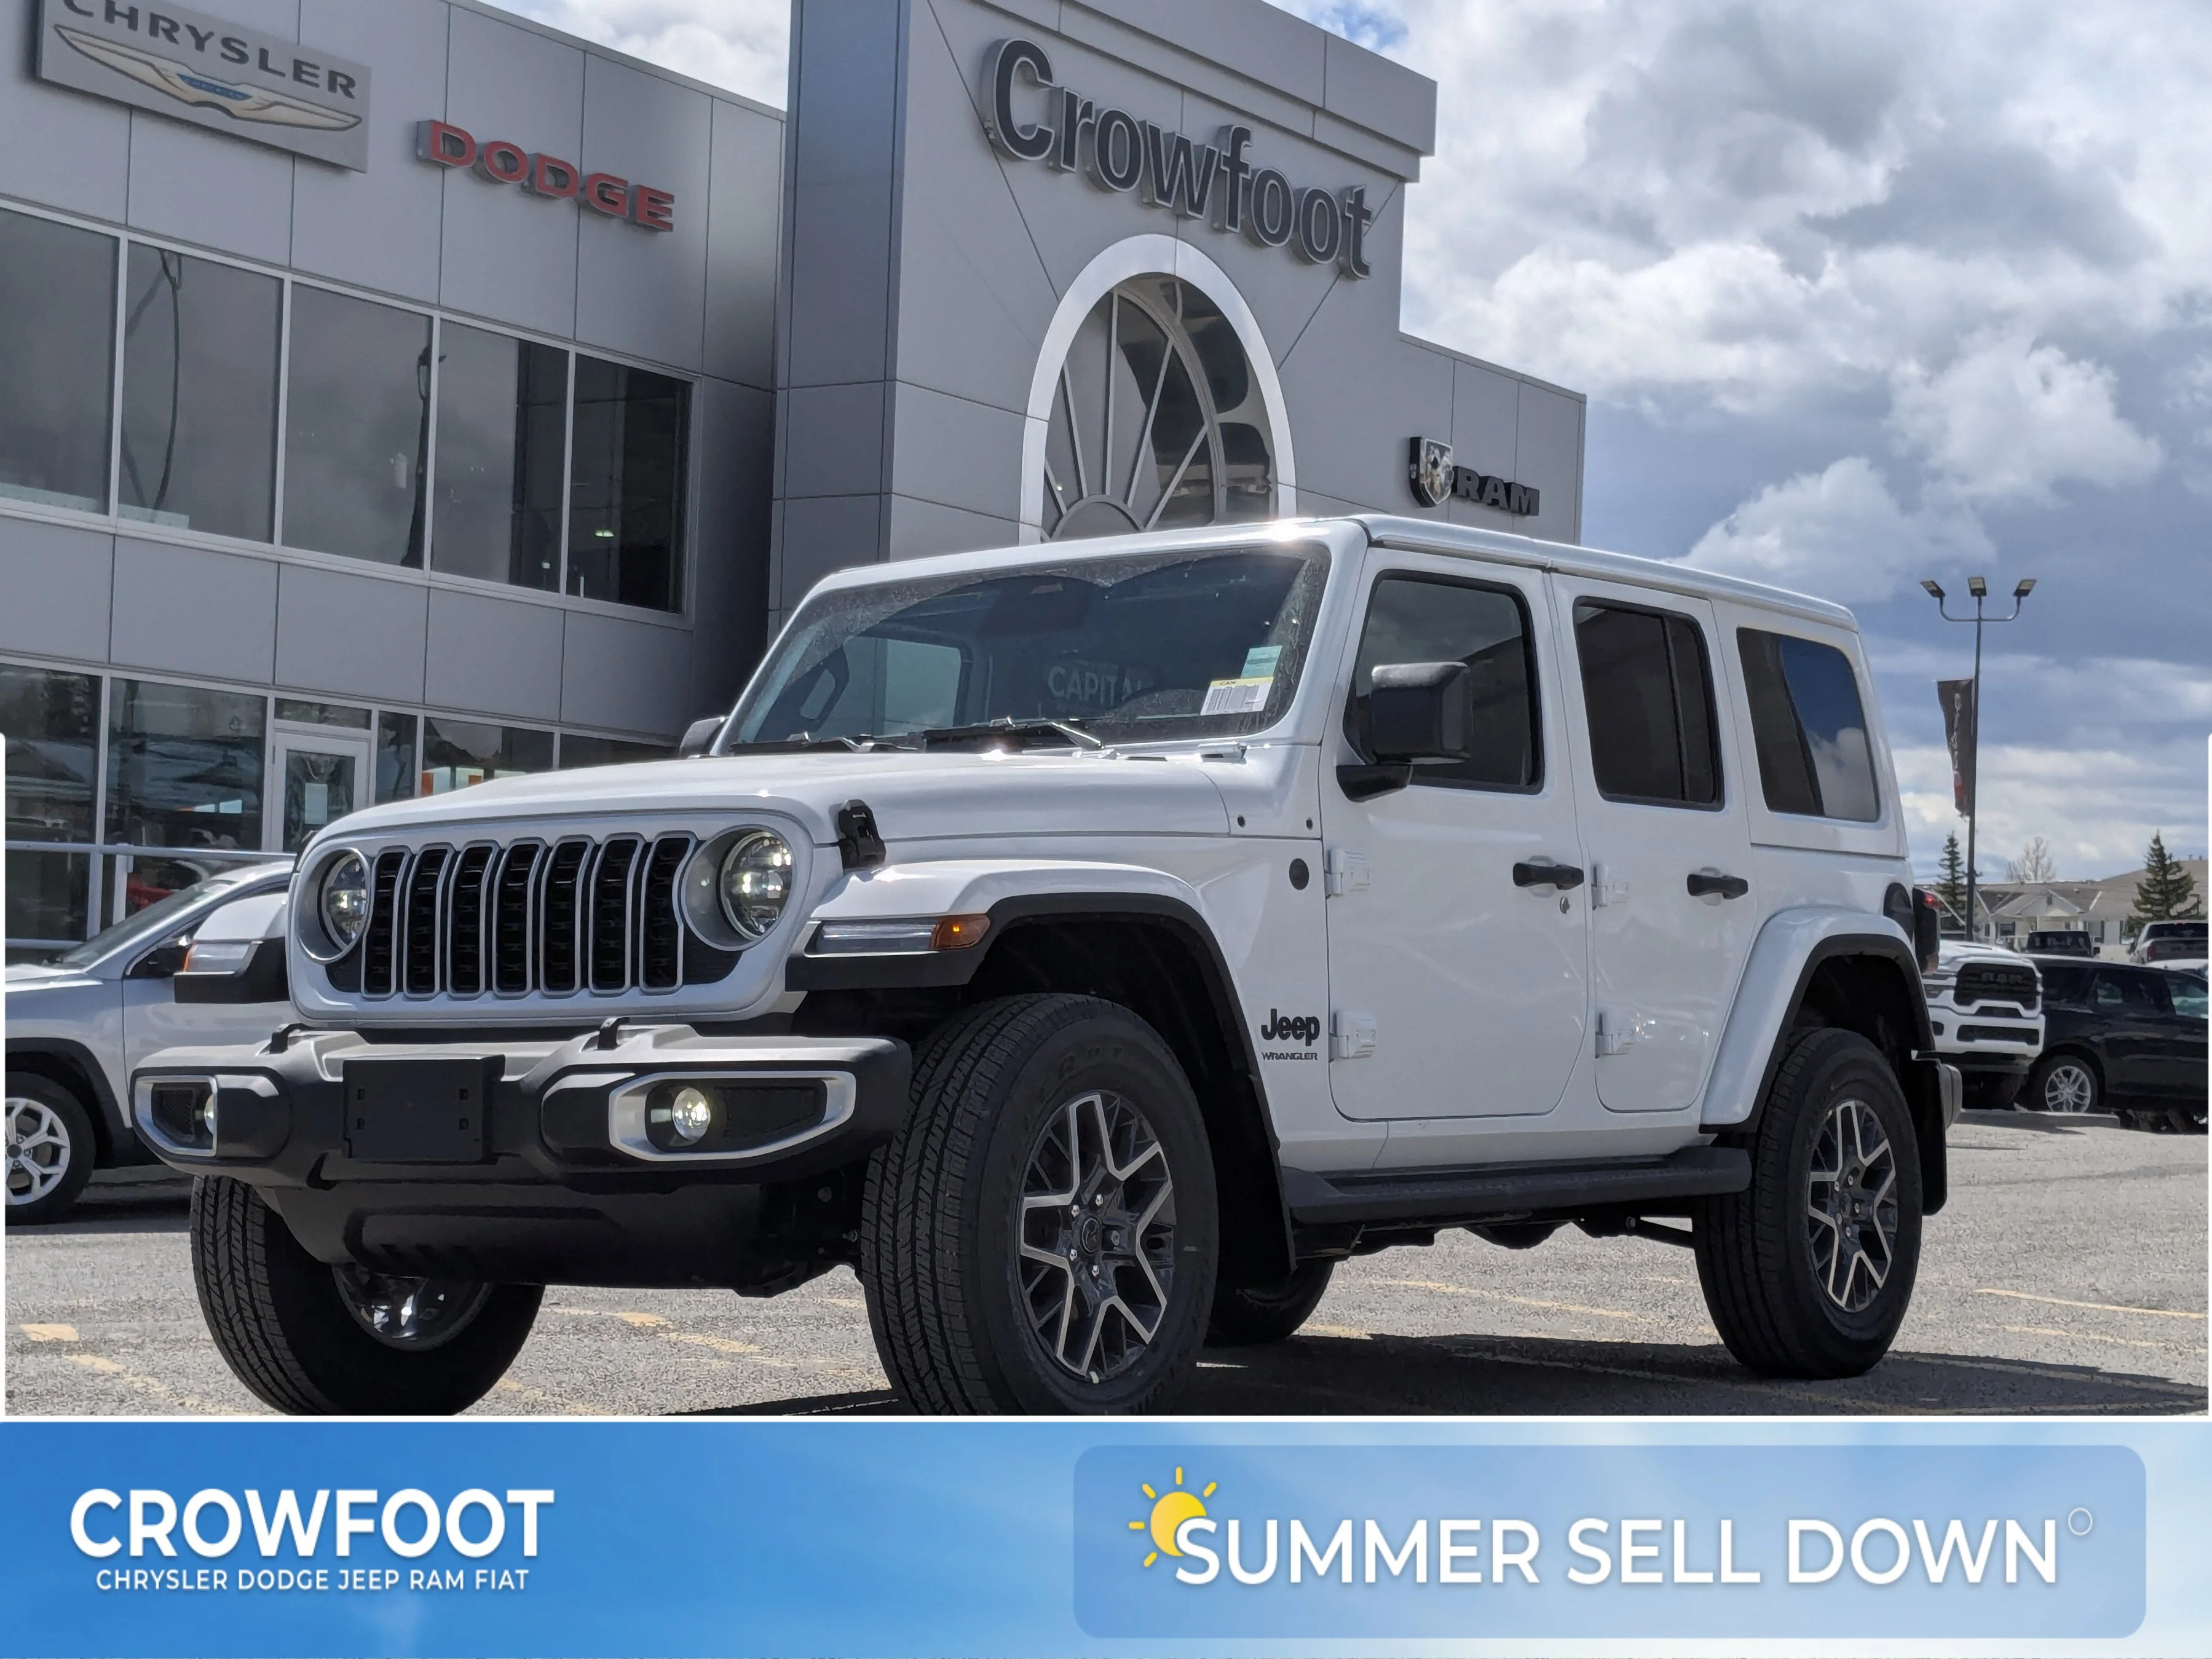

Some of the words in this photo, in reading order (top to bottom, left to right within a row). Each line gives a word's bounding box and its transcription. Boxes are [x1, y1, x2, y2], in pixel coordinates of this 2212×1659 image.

[425, 119, 674, 232] DODGE
[989, 38, 1373, 279] Crowfoot
[1453, 466, 1539, 516] RAM
[1261, 1008, 1321, 1047] Jeep
[1262, 1052, 1318, 1061] WRANGLER
